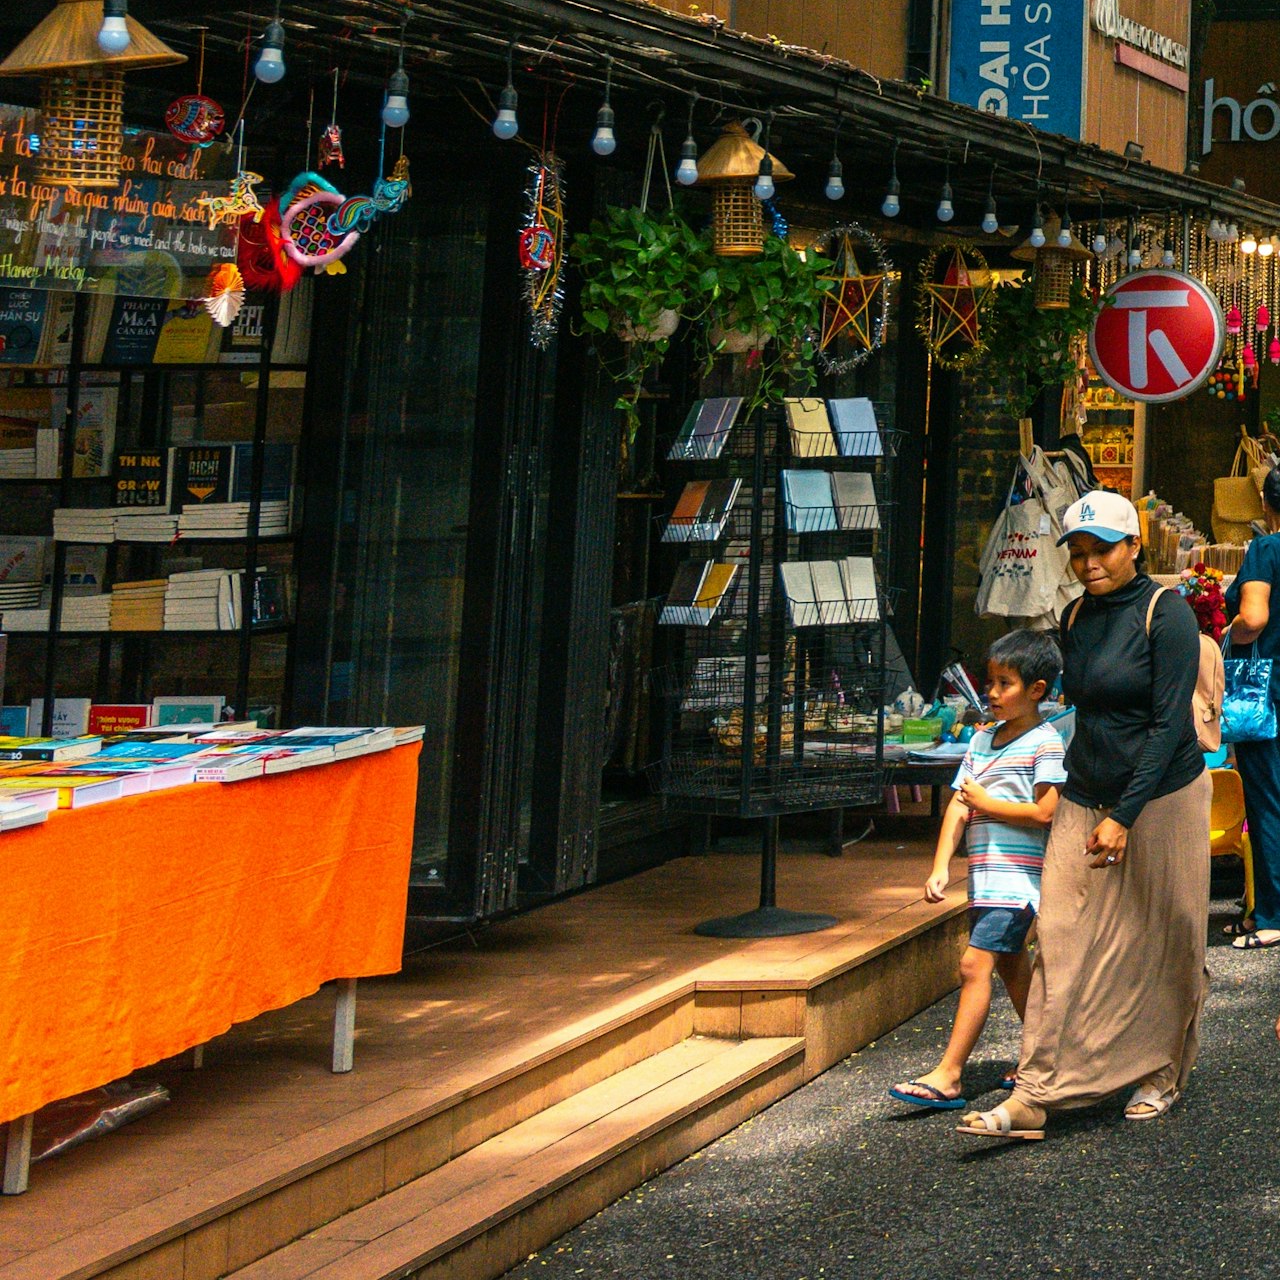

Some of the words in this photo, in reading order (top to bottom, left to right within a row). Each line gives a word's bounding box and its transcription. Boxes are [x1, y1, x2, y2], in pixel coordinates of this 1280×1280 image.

[1023, 35, 1051, 119] HOA
[84, 192, 108, 223] qua
[155, 231, 172, 251] and
[119, 455, 161, 468] THNK
